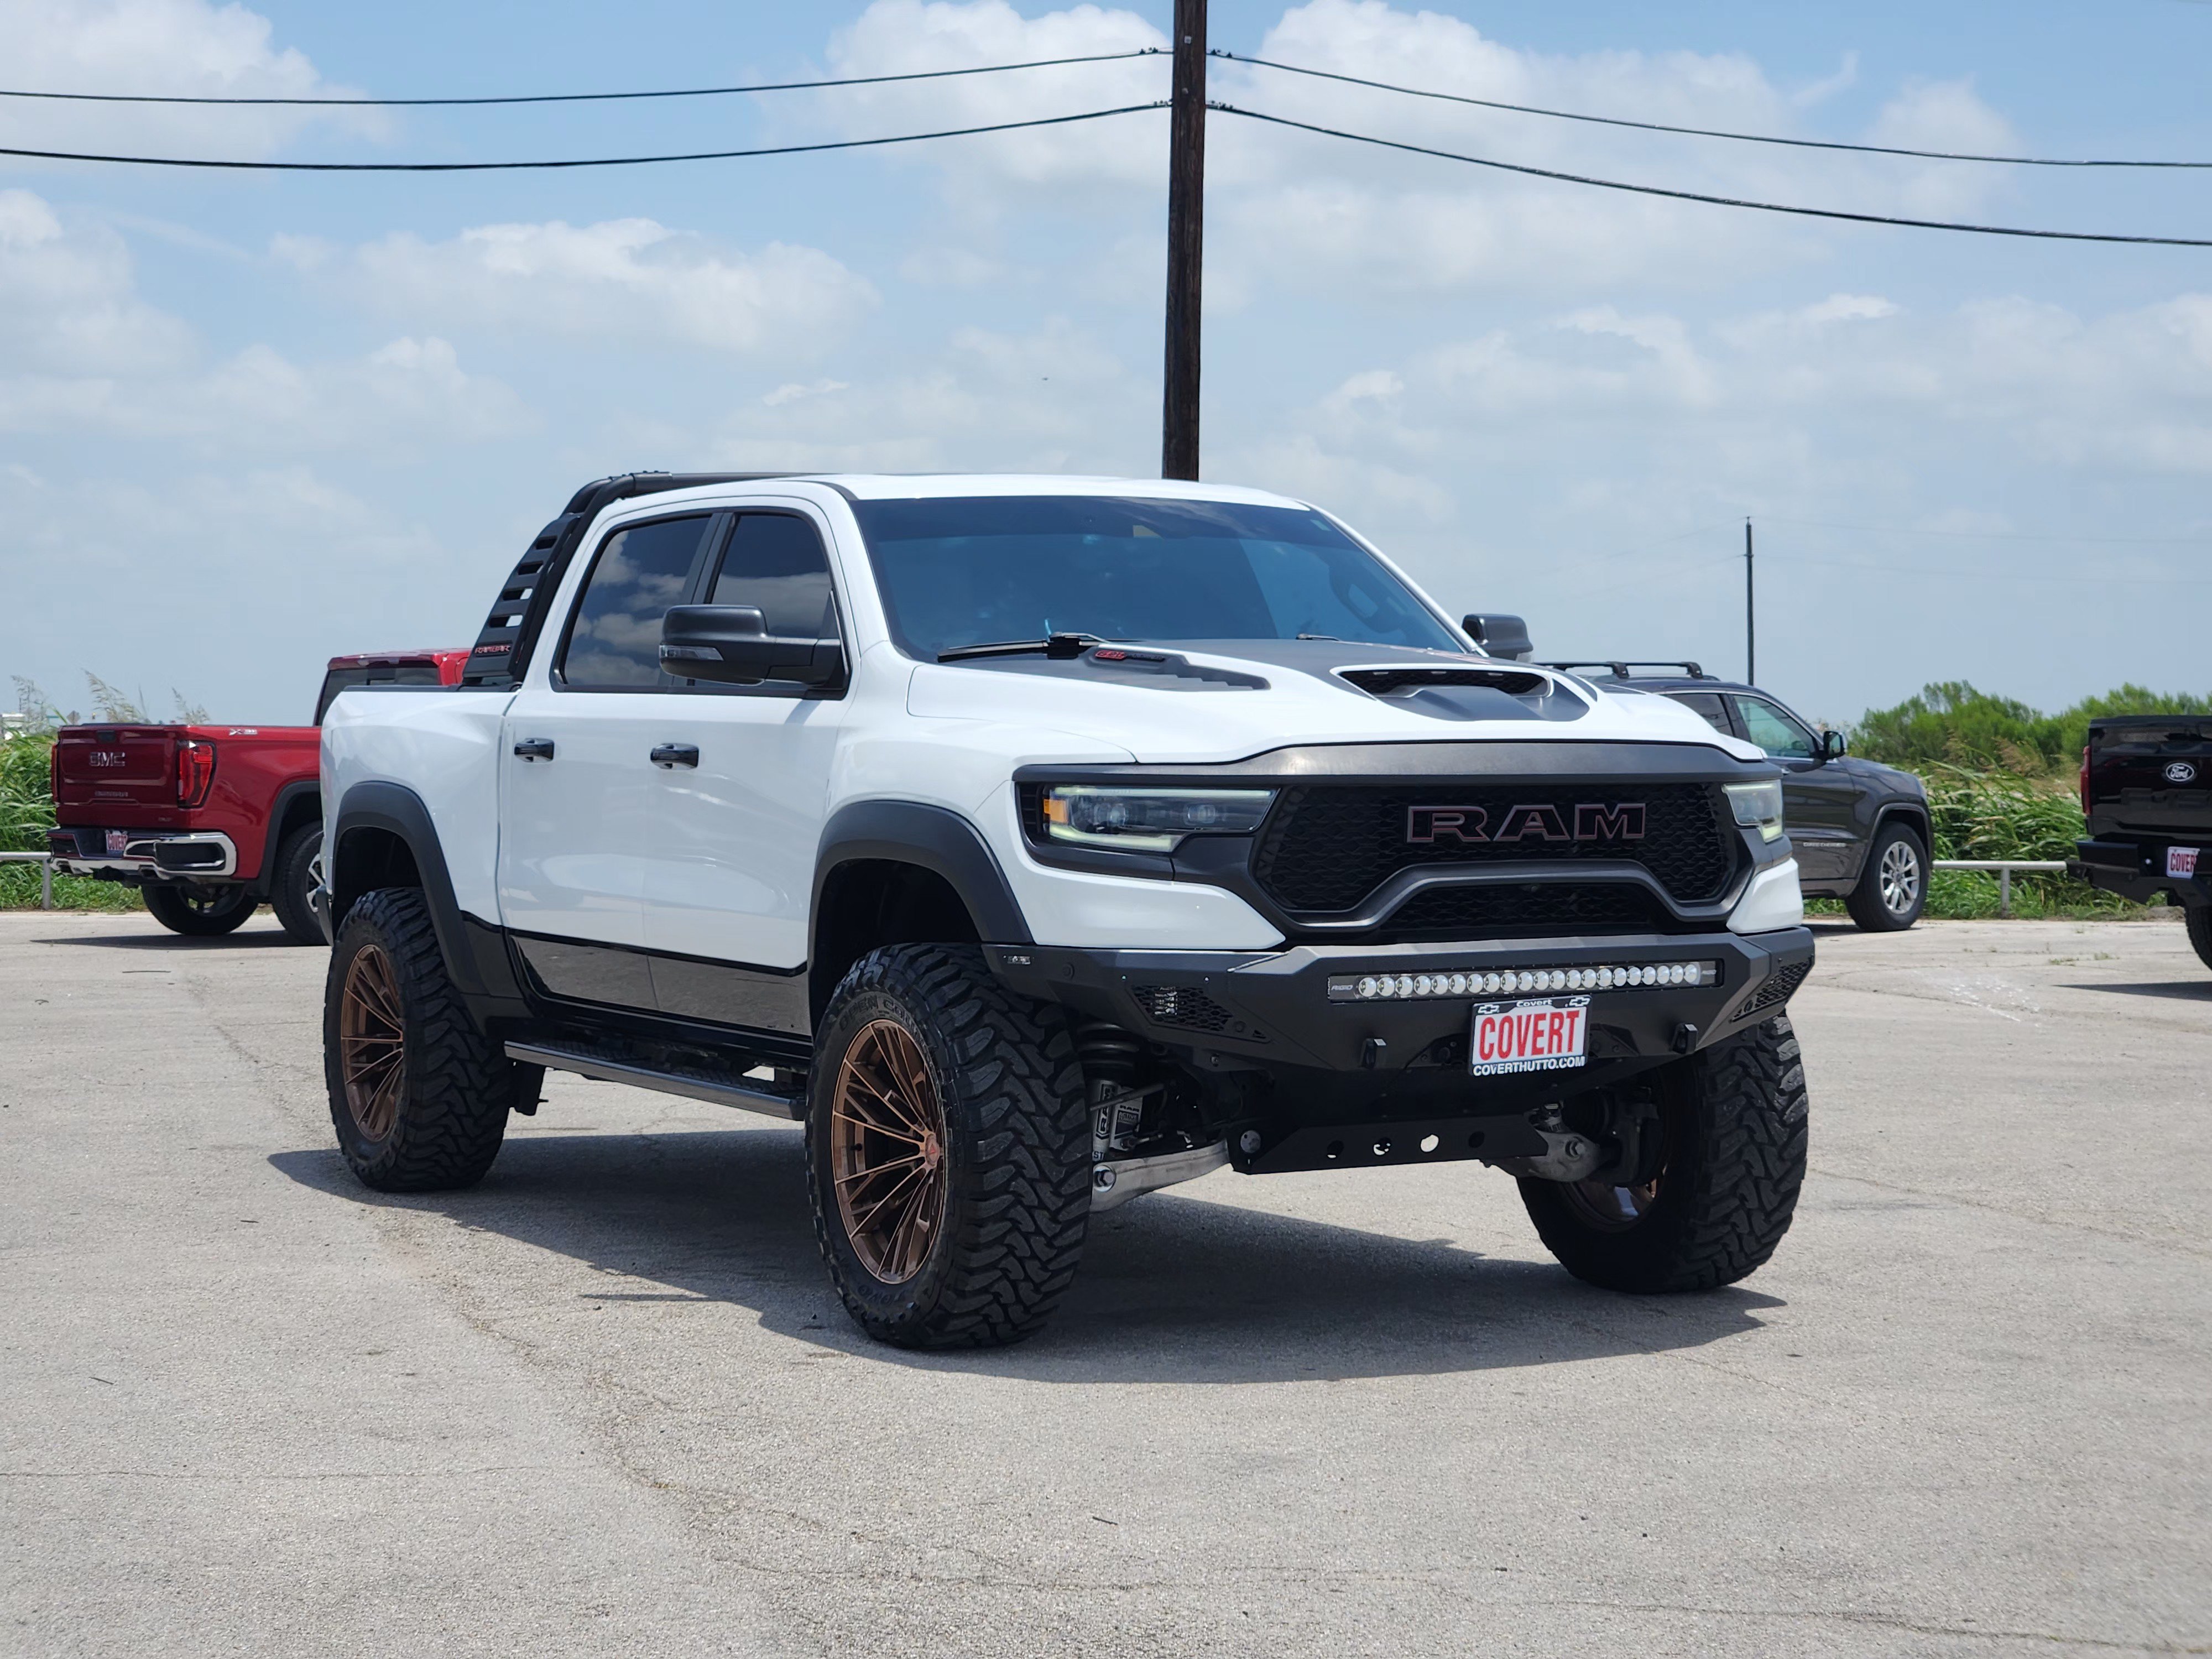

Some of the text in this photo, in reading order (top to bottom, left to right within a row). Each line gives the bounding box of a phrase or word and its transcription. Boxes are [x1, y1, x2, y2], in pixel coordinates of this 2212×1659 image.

[90, 752, 125, 766] GMC
[1407, 803, 1646, 843] RAM
[1516, 999, 1553, 1008] Covert
[1479, 1010, 1580, 1061] COVERT
[1473, 1056, 1585, 1076] COVERTHUTTO.COM
